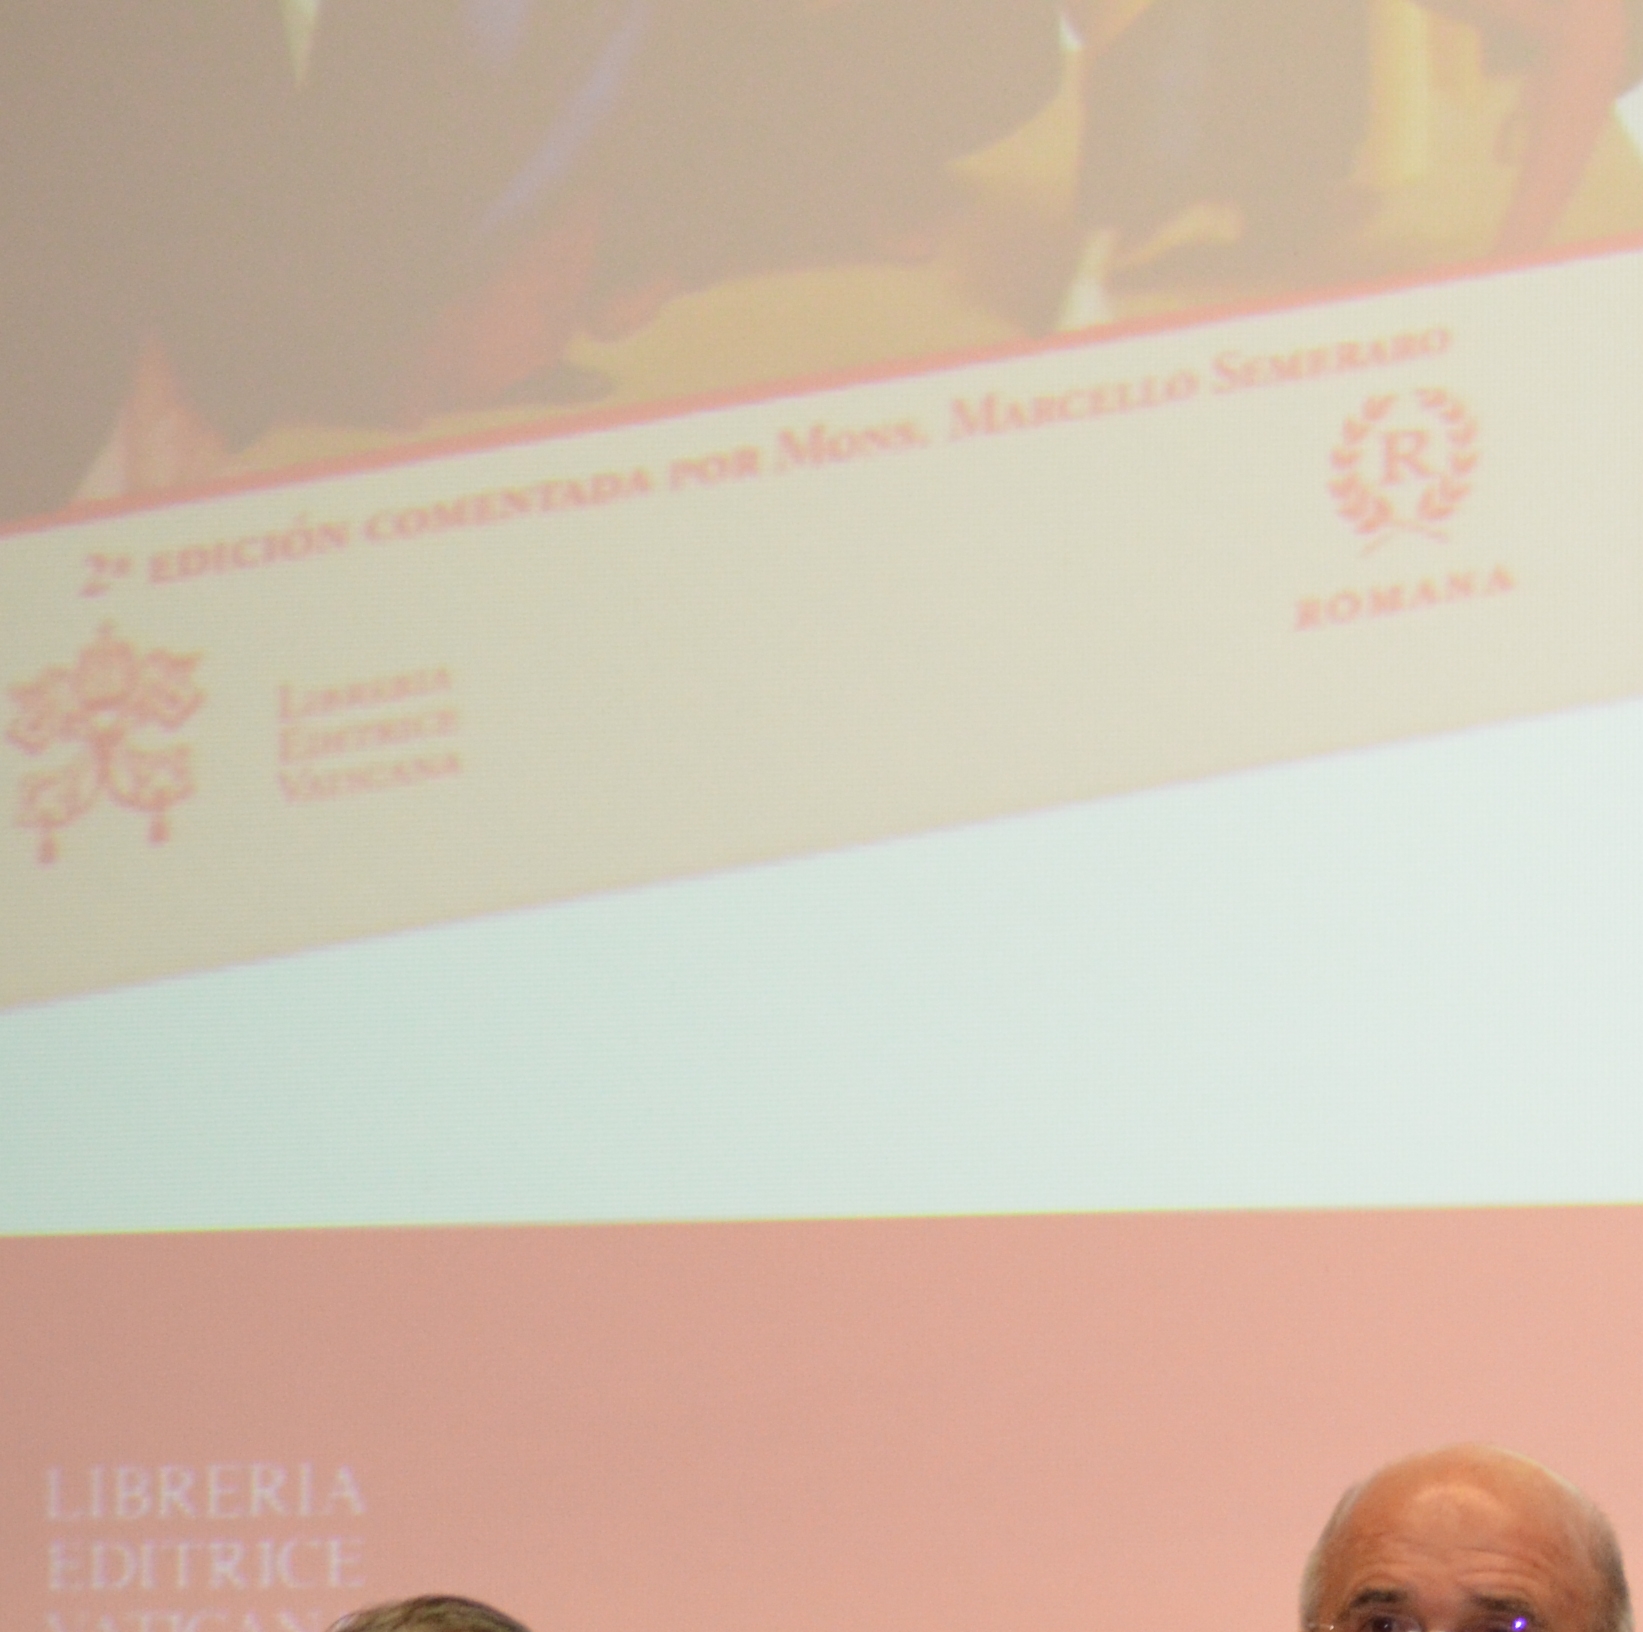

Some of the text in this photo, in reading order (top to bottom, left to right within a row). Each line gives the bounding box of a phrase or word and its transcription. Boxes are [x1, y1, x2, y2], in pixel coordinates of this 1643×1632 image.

[147, 511, 351, 586] EDICIÓN
[363, 467, 654, 543] COMENTADA
[667, 444, 763, 492] POR
[950, 368, 1199, 443] MARCELLO
[1211, 325, 1452, 395] SEMERARO
[1379, 426, 1439, 486] R
[1295, 562, 1517, 631] ROMANA
[45, 1462, 366, 1521] LIBRERIA
[46, 1537, 367, 1591] EDITRICE
